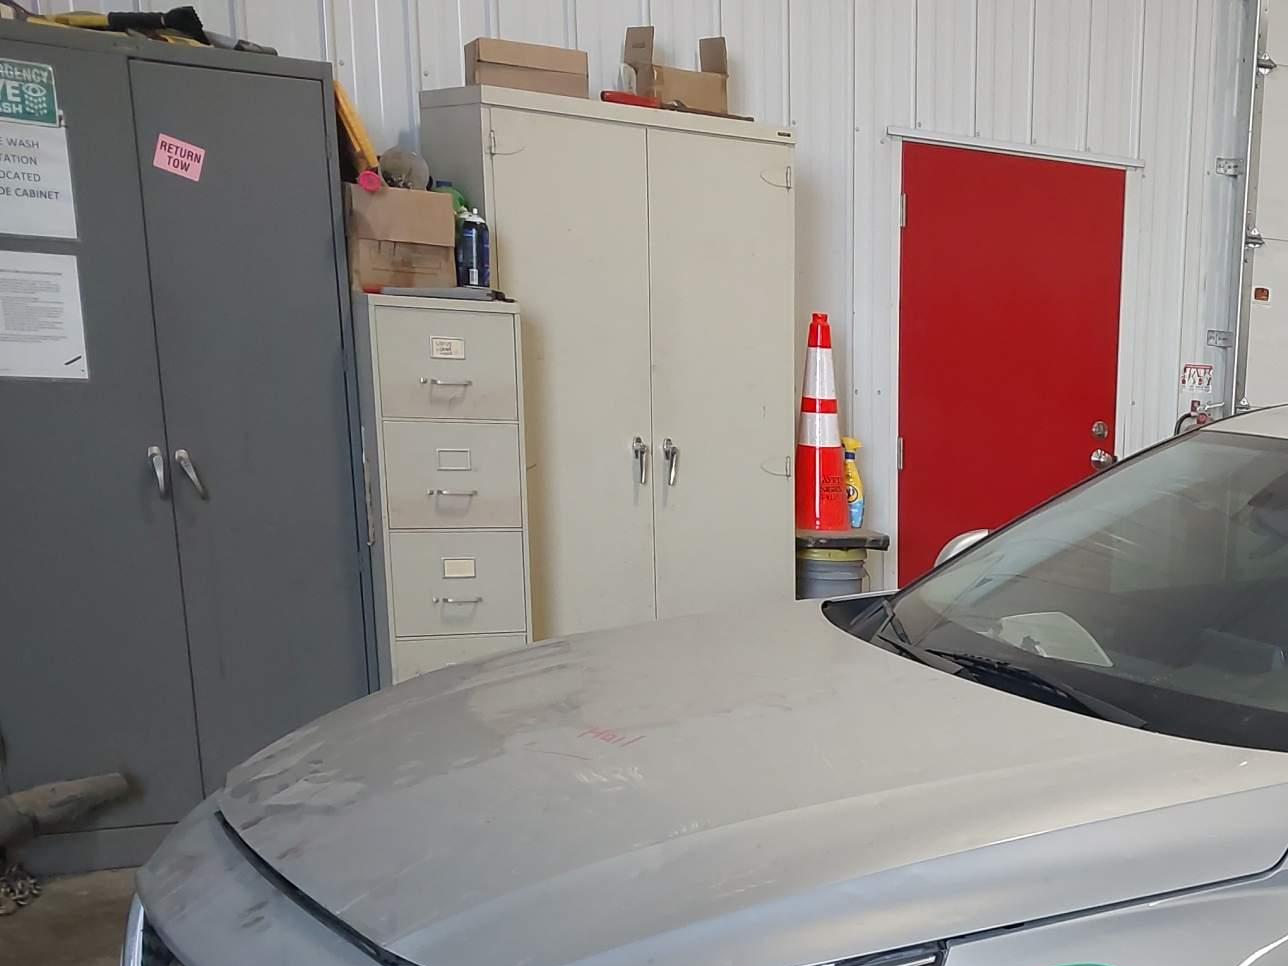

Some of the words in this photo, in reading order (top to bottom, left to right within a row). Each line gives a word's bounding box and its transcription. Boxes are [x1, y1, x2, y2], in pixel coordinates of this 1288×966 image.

[7, 137, 40, 150] WASH
[159, 140, 202, 165] RETURN
[167, 155, 191, 173] TOW
[14, 187, 61, 202] CABINET
